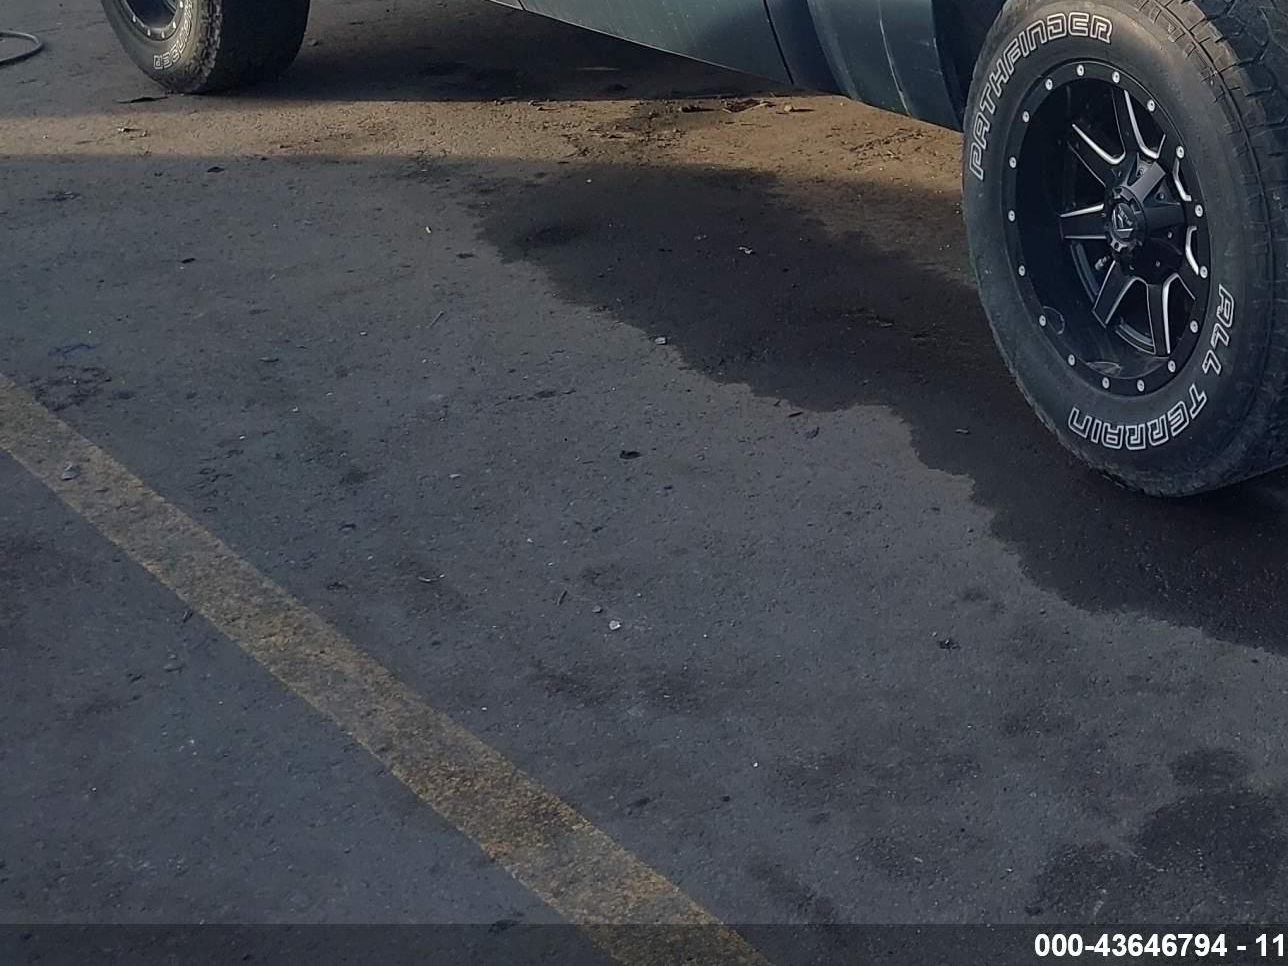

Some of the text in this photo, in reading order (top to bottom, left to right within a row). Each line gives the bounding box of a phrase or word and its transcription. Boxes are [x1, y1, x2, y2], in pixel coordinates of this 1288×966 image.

[968, 11, 1113, 181] PATHFINDER
[1067, 283, 1235, 450] ALL TERRAIN
